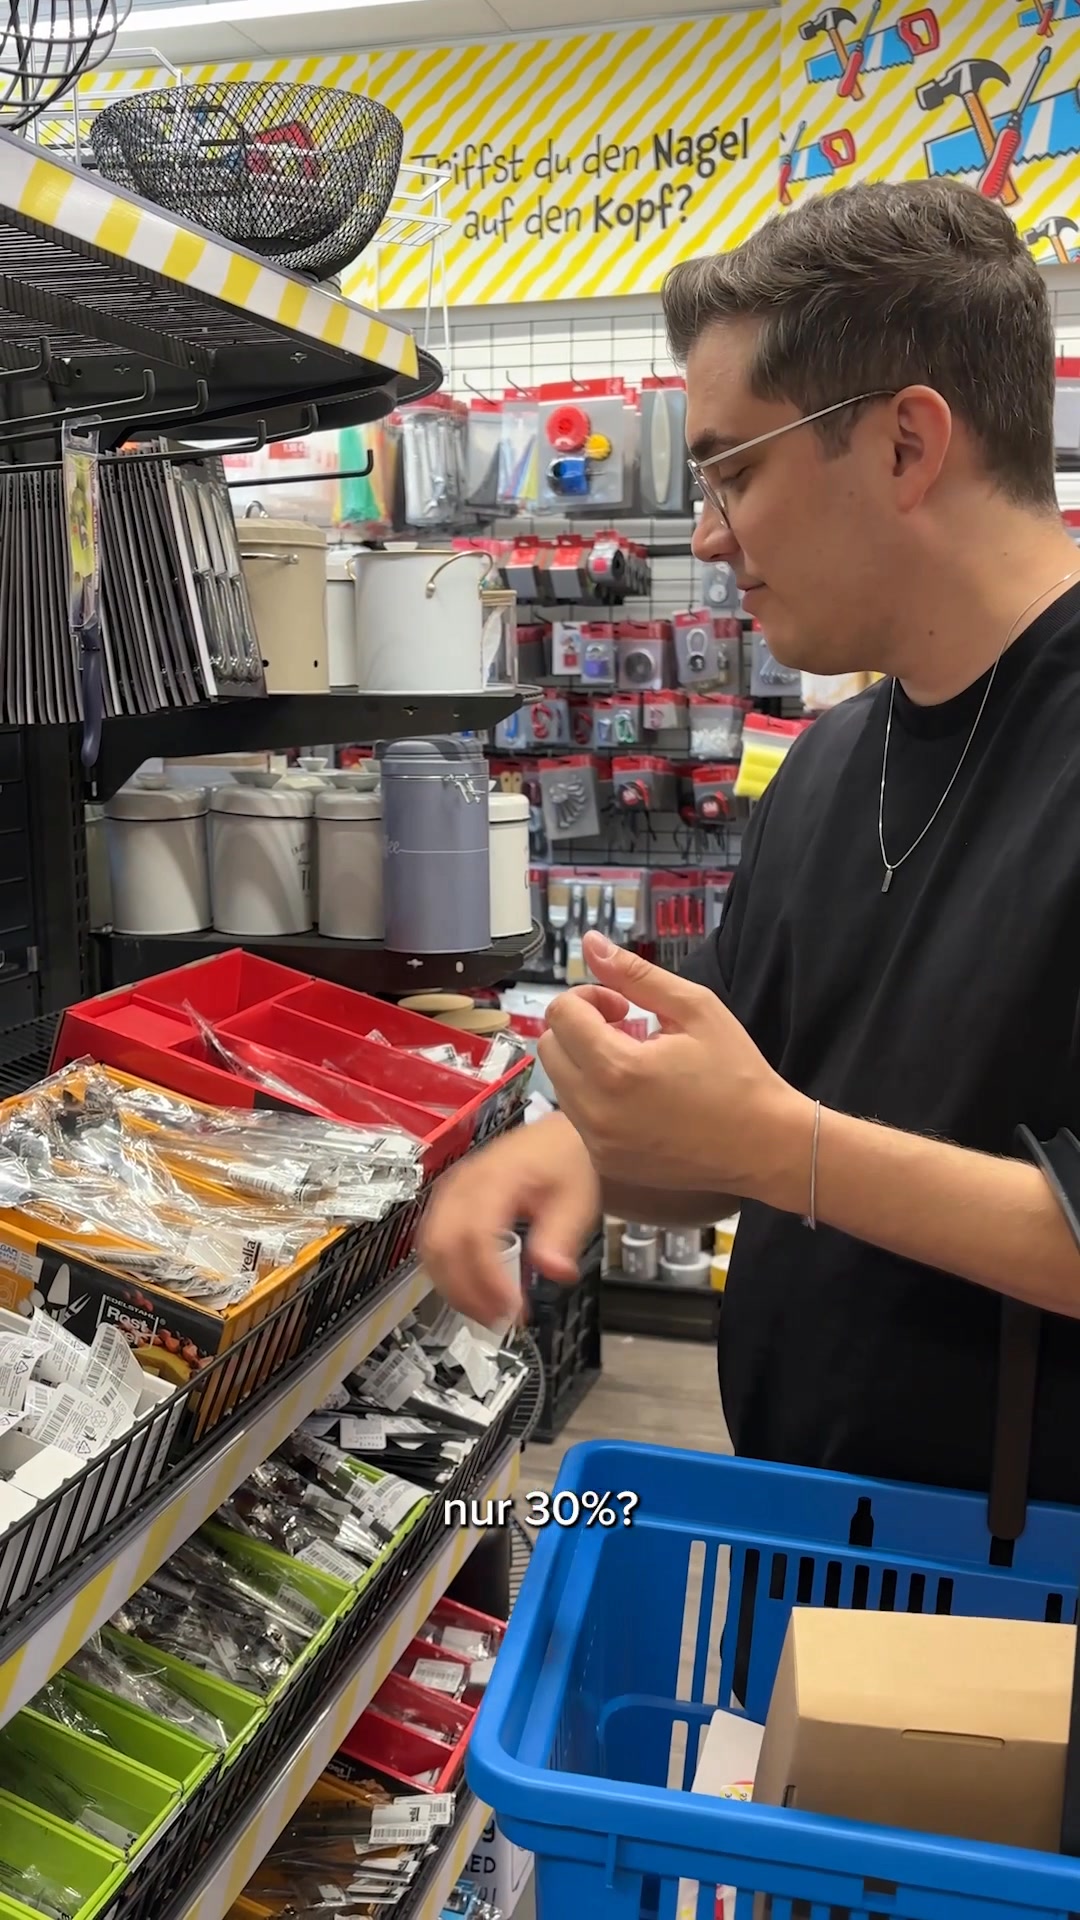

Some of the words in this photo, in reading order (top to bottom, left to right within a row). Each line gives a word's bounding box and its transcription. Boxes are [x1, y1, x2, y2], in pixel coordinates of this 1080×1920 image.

[409, 143, 524, 190] Triffst
[534, 138, 572, 183] du
[582, 134, 640, 178] den
[653, 117, 749, 178] Nagel
[464, 196, 515, 243] auf
[525, 195, 582, 240] den
[593, 183, 693, 242] Kopf?
[106, 1295, 156, 1321] EDELSTAHL
[106, 1305, 150, 1334] Rost
